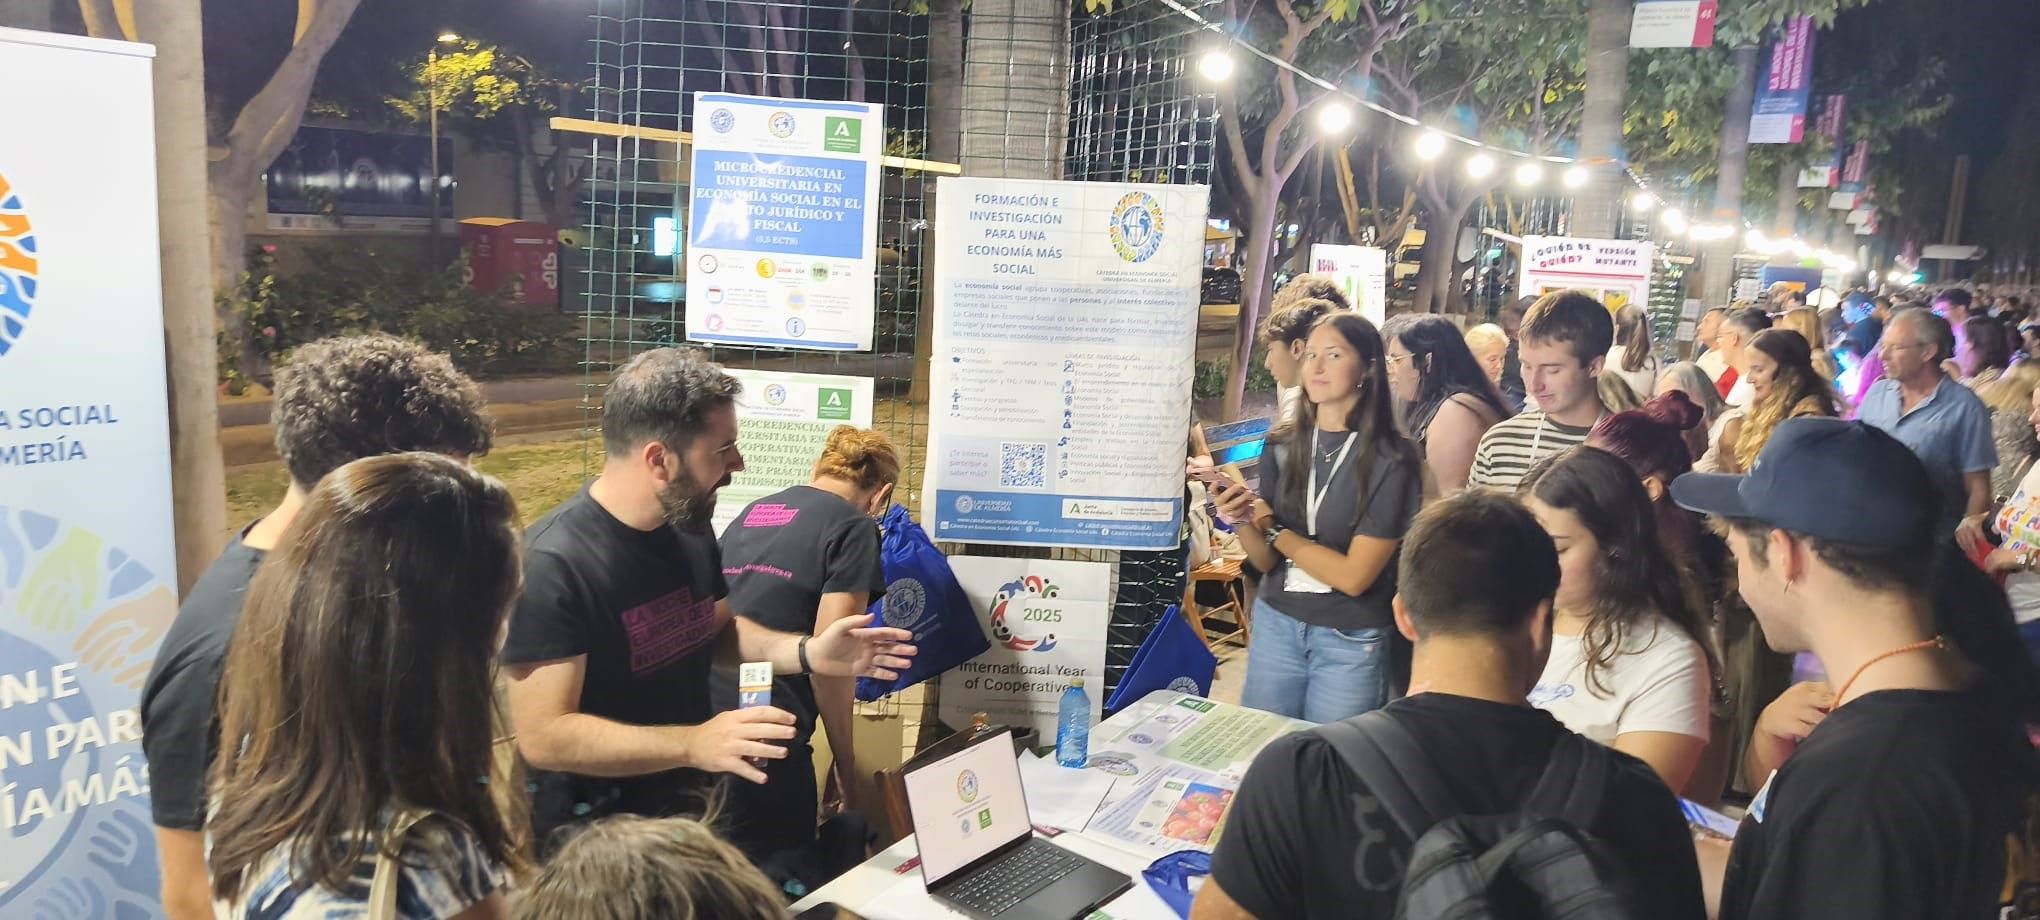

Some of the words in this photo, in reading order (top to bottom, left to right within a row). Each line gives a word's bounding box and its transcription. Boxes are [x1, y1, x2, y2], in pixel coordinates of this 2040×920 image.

[716, 175, 821, 193] UNIVERSITARIA
[823, 182, 843, 194] EN
[770, 192, 820, 206] SOCIAL
[822, 197, 842, 208] EN
[844, 198, 862, 210] EL
[974, 193, 1049, 208] FORMACIÓN
[1051, 197, 1059, 208] E
[767, 206, 833, 221] JURÍDICO
[835, 211, 845, 222] Y
[969, 210, 1063, 225] INVESTIGACIÓN
[753, 219, 803, 233] FISCAL
[984, 228, 1017, 241] PARA
[1019, 230, 1046, 242] UNA
[967, 243, 1035, 258] ECONOMÍA
[1036, 245, 1063, 260] MÁS
[992, 263, 1036, 275] SOCIAL
[964, 282, 999, 290] economía
[1001, 283, 1022, 291] social
[19, 404, 119, 430] SOCIAL
[0, 434, 88, 466] MERÍA
[1023, 608, 1063, 623] 2025
[960, 661, 1050, 677] International
[1055, 666, 1087, 677] Year
[51, 662, 80, 700] E
[964, 678, 980, 690] of
[984, 679, 1071, 695] Cooperative
[46, 708, 145, 761] PAR
